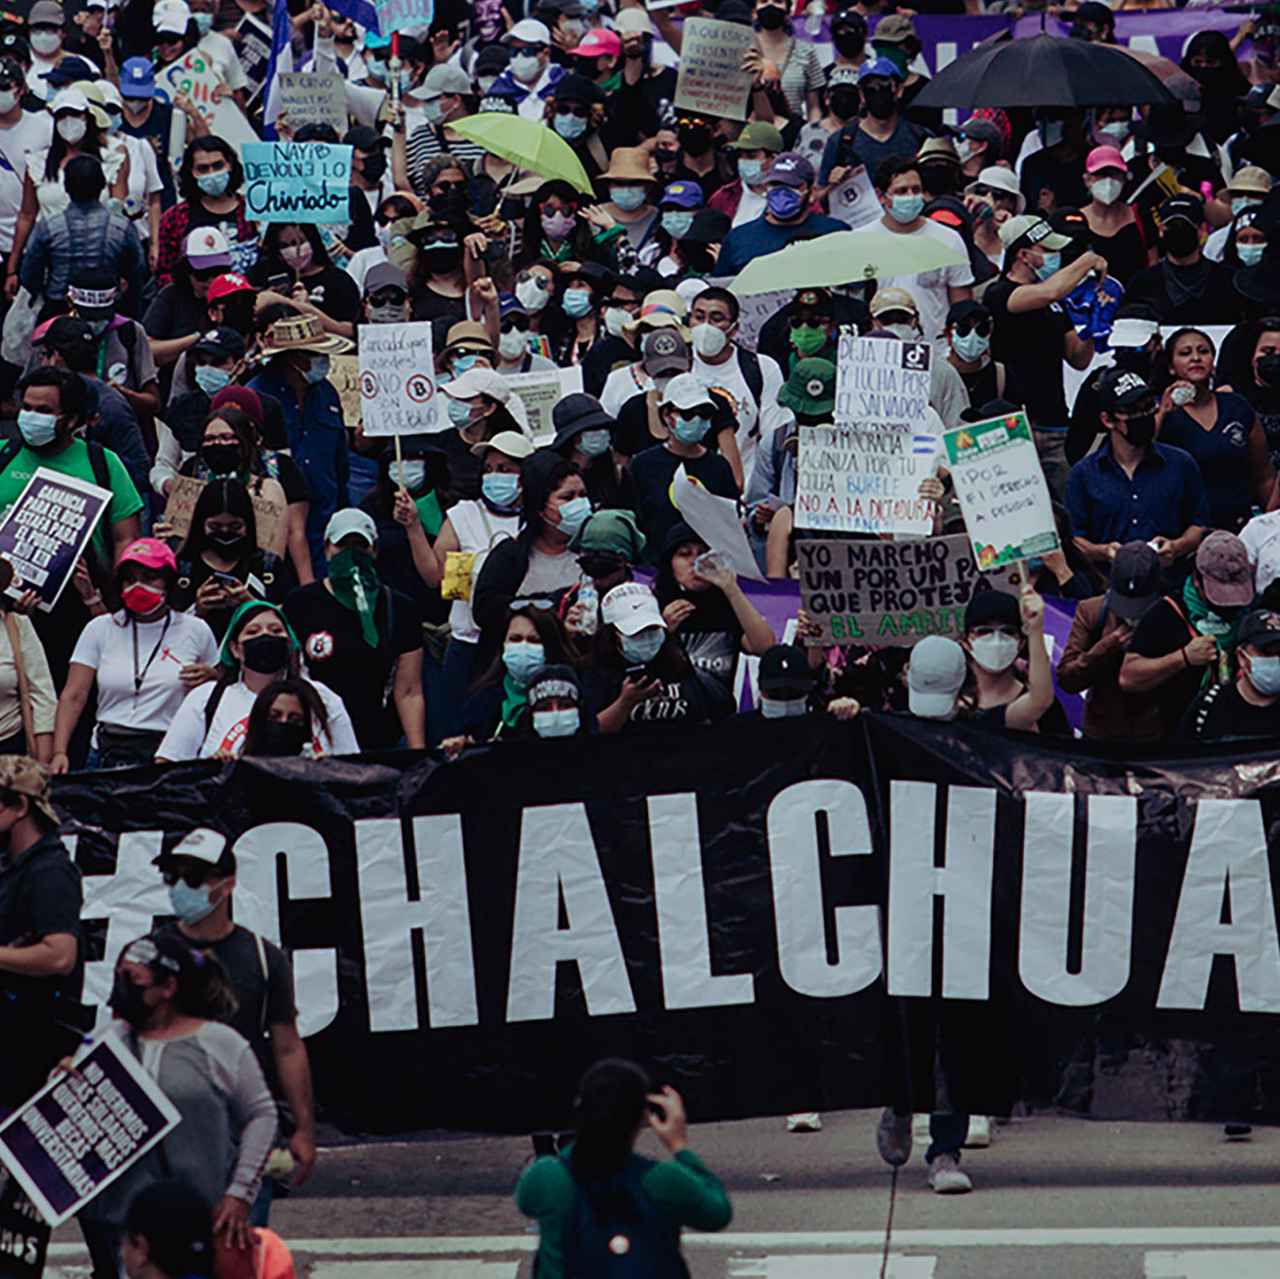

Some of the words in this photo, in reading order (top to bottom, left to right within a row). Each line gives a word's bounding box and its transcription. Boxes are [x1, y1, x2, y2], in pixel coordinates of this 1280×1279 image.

[274, 144, 331, 161] NAYIB
[325, 161, 346, 178] LO
[247, 180, 348, 214] Chiviado
[840, 338, 877, 362] DEJA
[885, 341, 899, 363] EL
[376, 373, 402, 396] NO
[854, 368, 898, 393] LUCHA
[902, 371, 930, 395] POR
[838, 393, 851, 415] EL
[858, 393, 927, 421] SALVADOR
[801, 428, 817, 447] LA
[825, 429, 904, 455] DEMOCRACIA
[900, 456, 917, 475] TU
[799, 495, 820, 513] NO
[826, 496, 840, 514] A
[846, 497, 862, 516] LA
[801, 545, 832, 569] YO
[847, 541, 950, 569] MARCHO
[805, 570, 842, 591] UN
[854, 568, 901, 591] POR
[909, 564, 948, 586] UN
[810, 592, 862, 614] QUE
[830, 615, 865, 639] EL
[51, 1082, 105, 1145] QUEREMOS
[82, 1060, 106, 1086] NO
[95, 1077, 150, 1142] QUEREMOS
[20, 1103, 98, 1199] UNIVERSITARIAS
